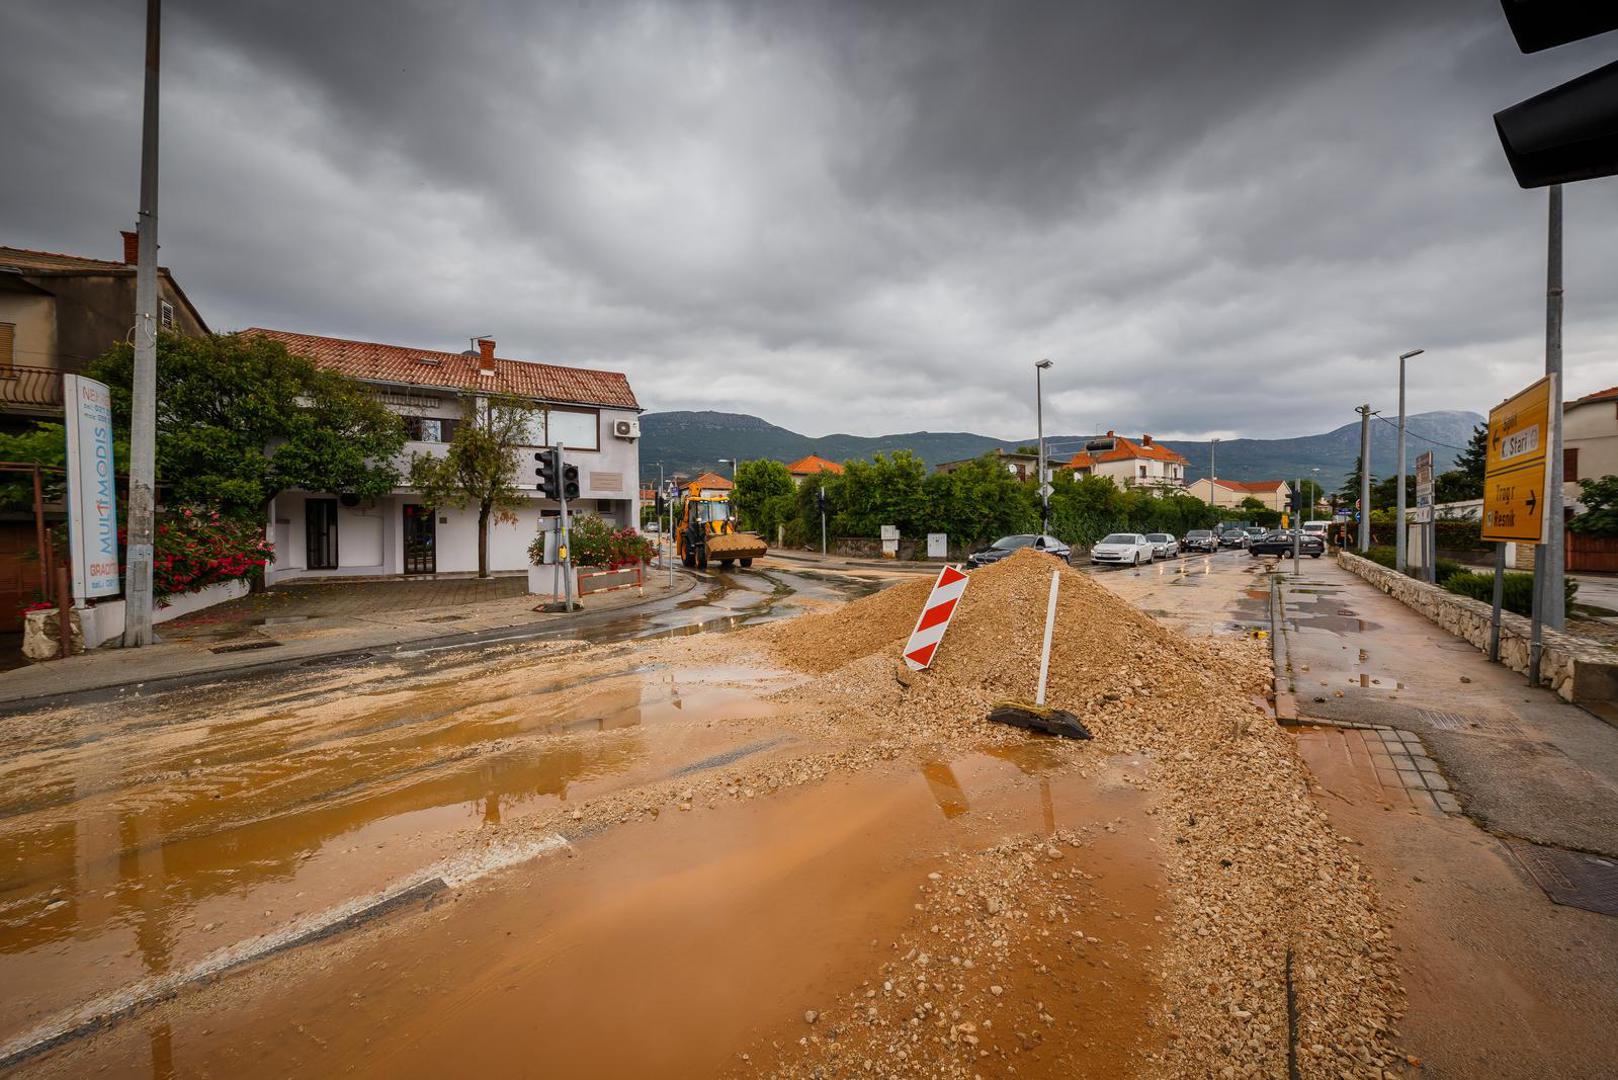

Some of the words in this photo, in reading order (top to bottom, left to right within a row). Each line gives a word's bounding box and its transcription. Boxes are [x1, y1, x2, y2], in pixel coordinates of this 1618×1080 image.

[1510, 432, 1528, 455] Stari
[94, 427, 112, 555] MULTIMODIS
[1496, 484, 1516, 505] Trogr
[1494, 509, 1516, 528] Resnik
